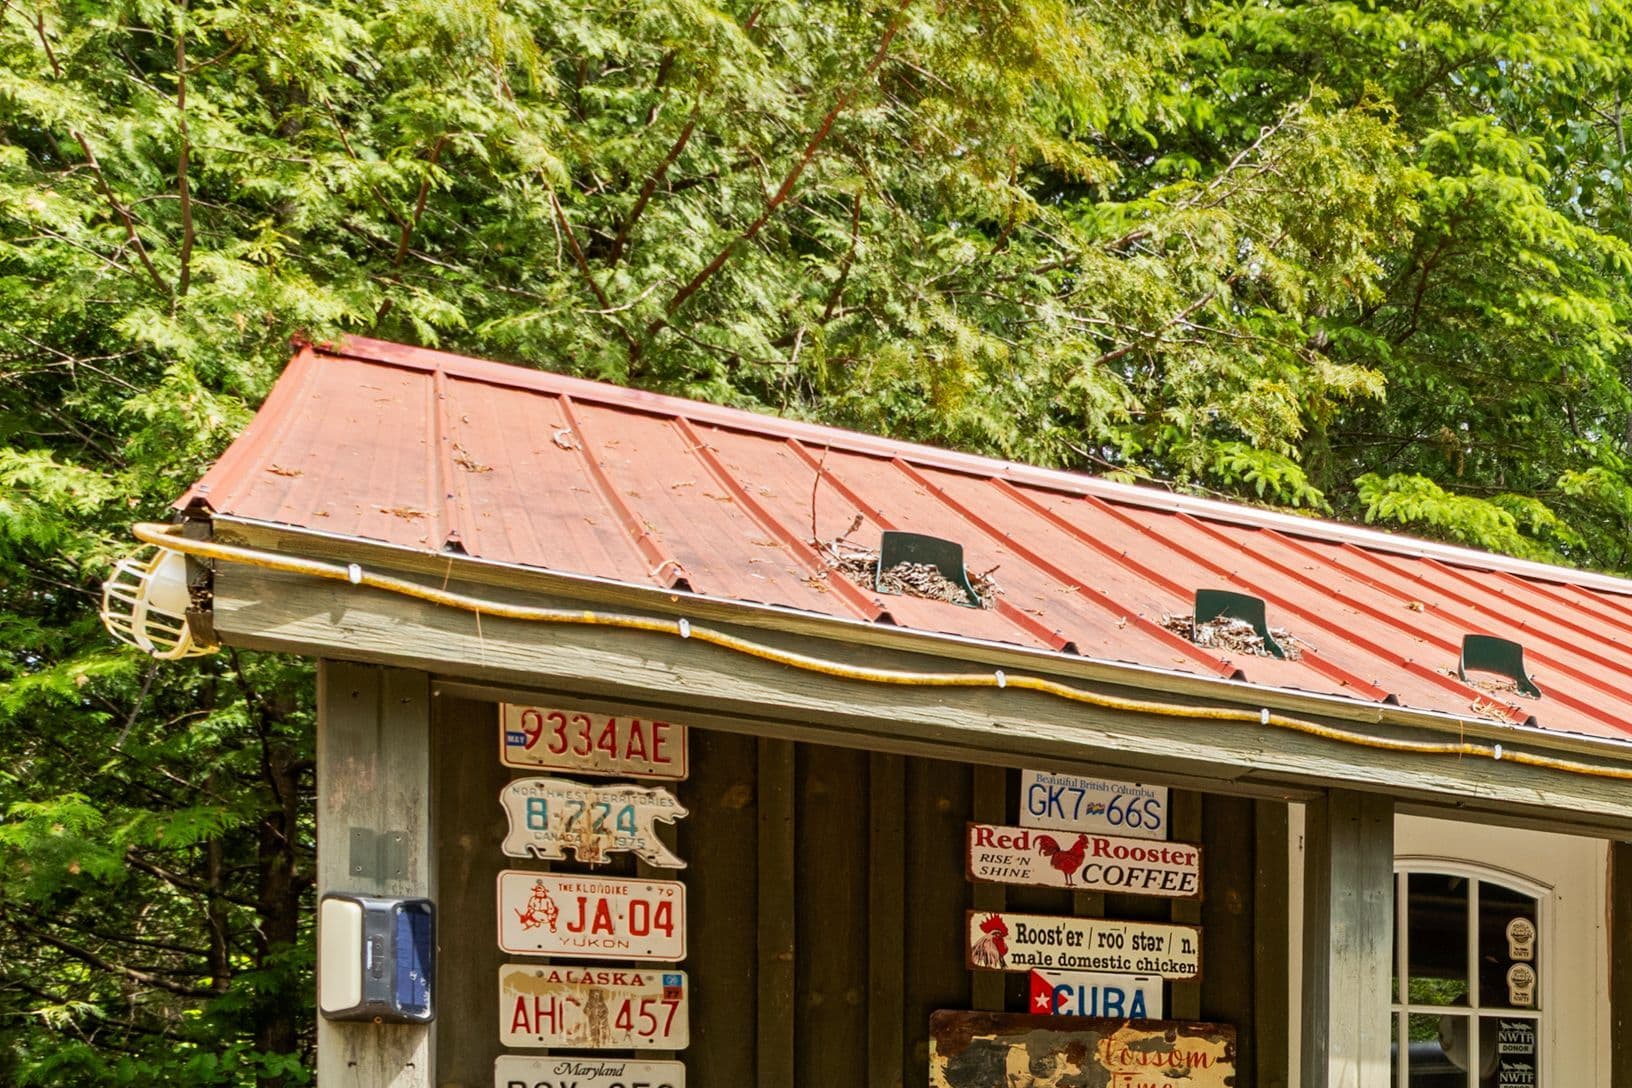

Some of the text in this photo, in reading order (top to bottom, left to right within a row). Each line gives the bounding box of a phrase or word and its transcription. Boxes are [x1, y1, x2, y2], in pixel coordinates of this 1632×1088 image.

[521, 708, 672, 764] 9334AE
[511, 787, 674, 807] NORTHWEST TERRITORIES
[1036, 773, 1155, 799] Beautiful British Columbia
[1028, 783, 1086, 821] GK7
[534, 831, 582, 844] CANADA
[974, 826, 1196, 867] Red Rooster
[980, 853, 1012, 865] RISE
[979, 866, 1031, 879] SHINE
[1081, 863, 1197, 893] COFFEE
[559, 937, 630, 948] YUKON
[1011, 951, 1198, 974] male domestic chicken
[547, 971, 645, 987] ALASKA
[1052, 984, 1148, 1020] CUBA
[615, 999, 679, 1038] 457
[553, 1062, 625, 1080] Maryland
